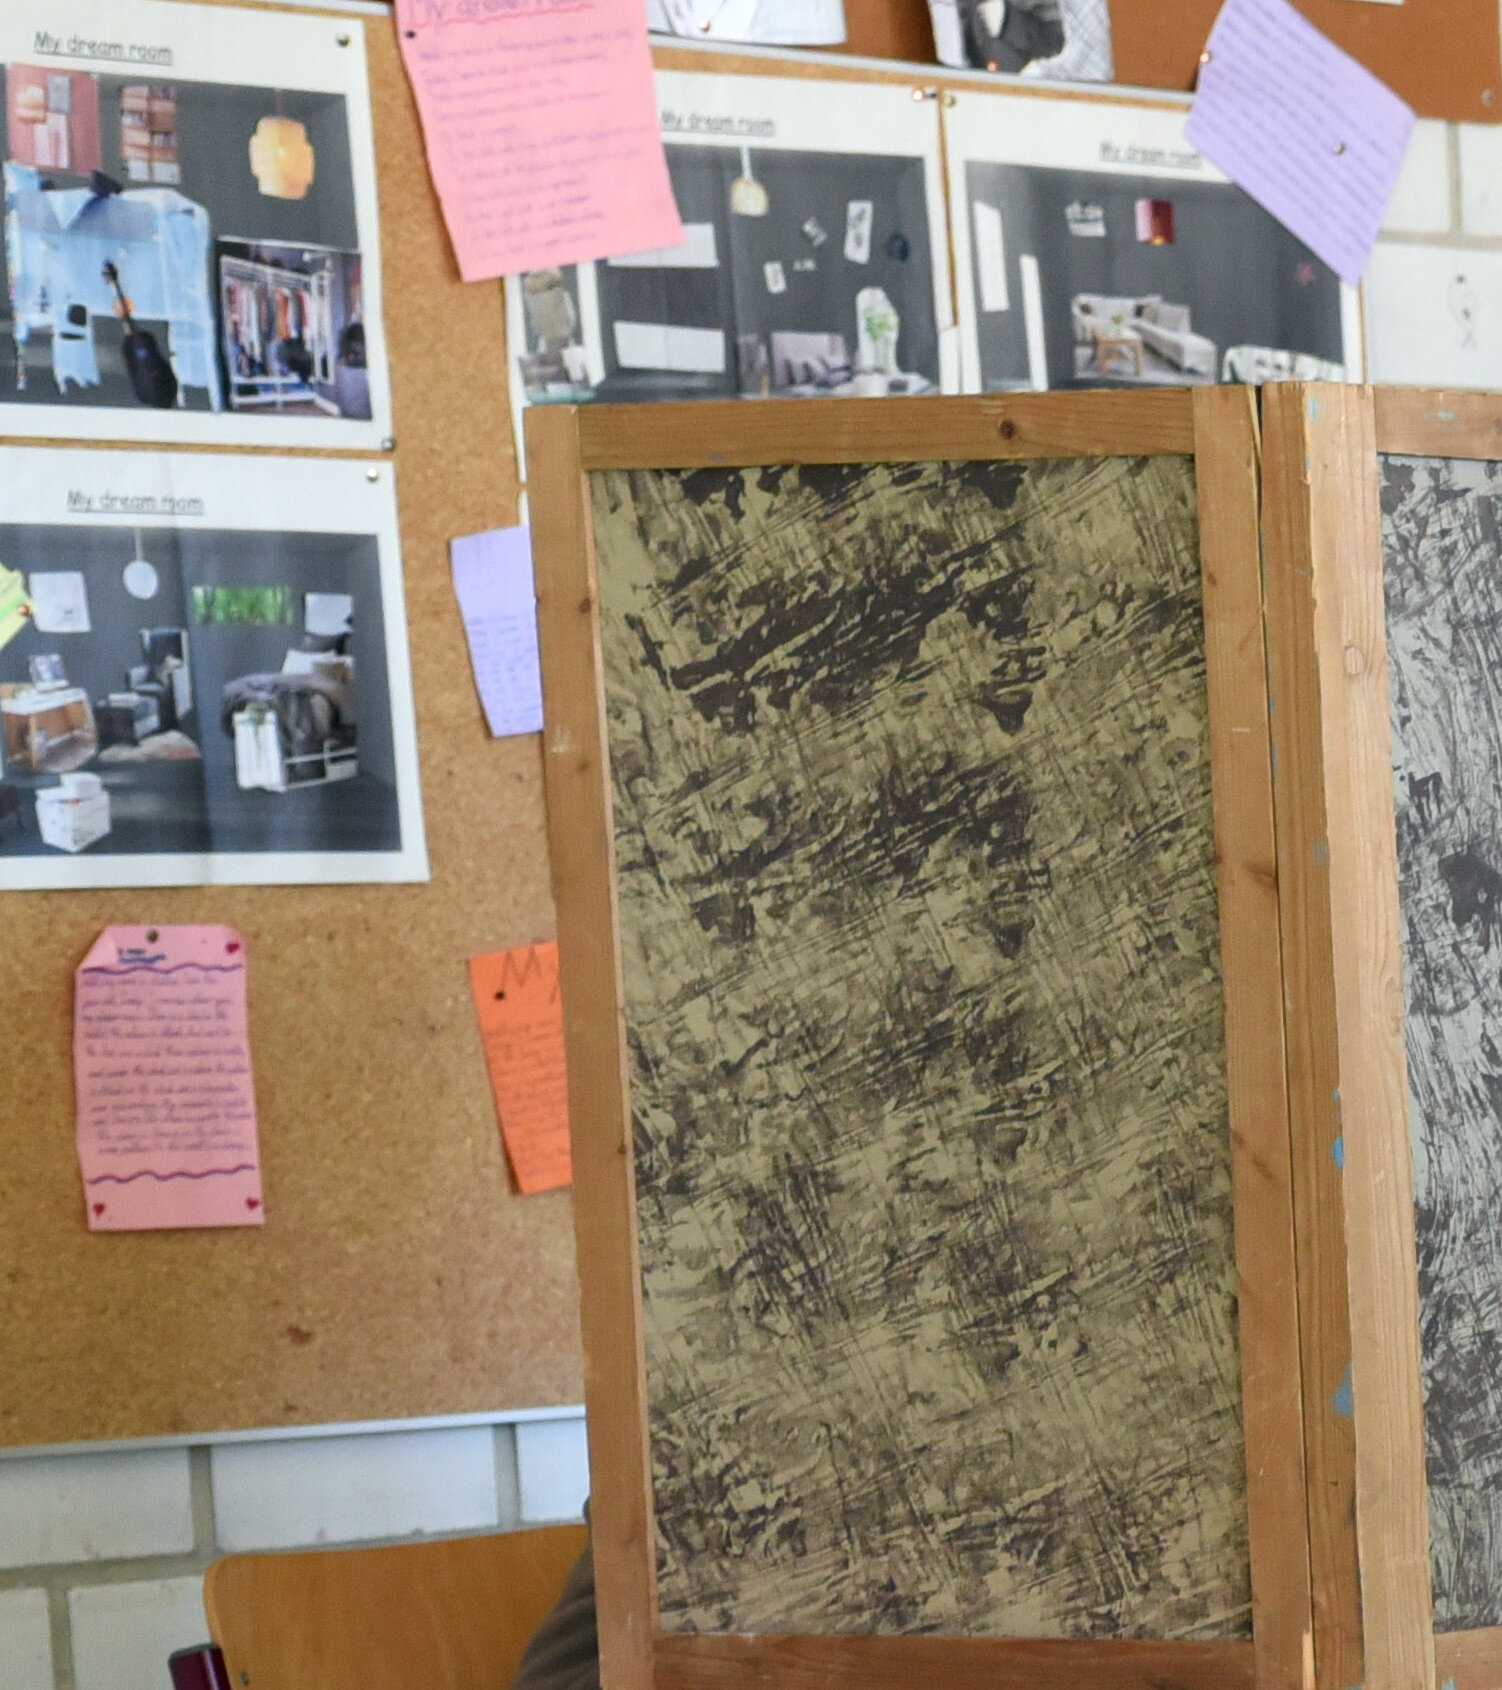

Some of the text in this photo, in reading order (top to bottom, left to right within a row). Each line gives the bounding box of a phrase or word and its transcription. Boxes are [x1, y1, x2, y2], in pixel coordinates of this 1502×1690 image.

[35, 31, 172, 64] My dream room
